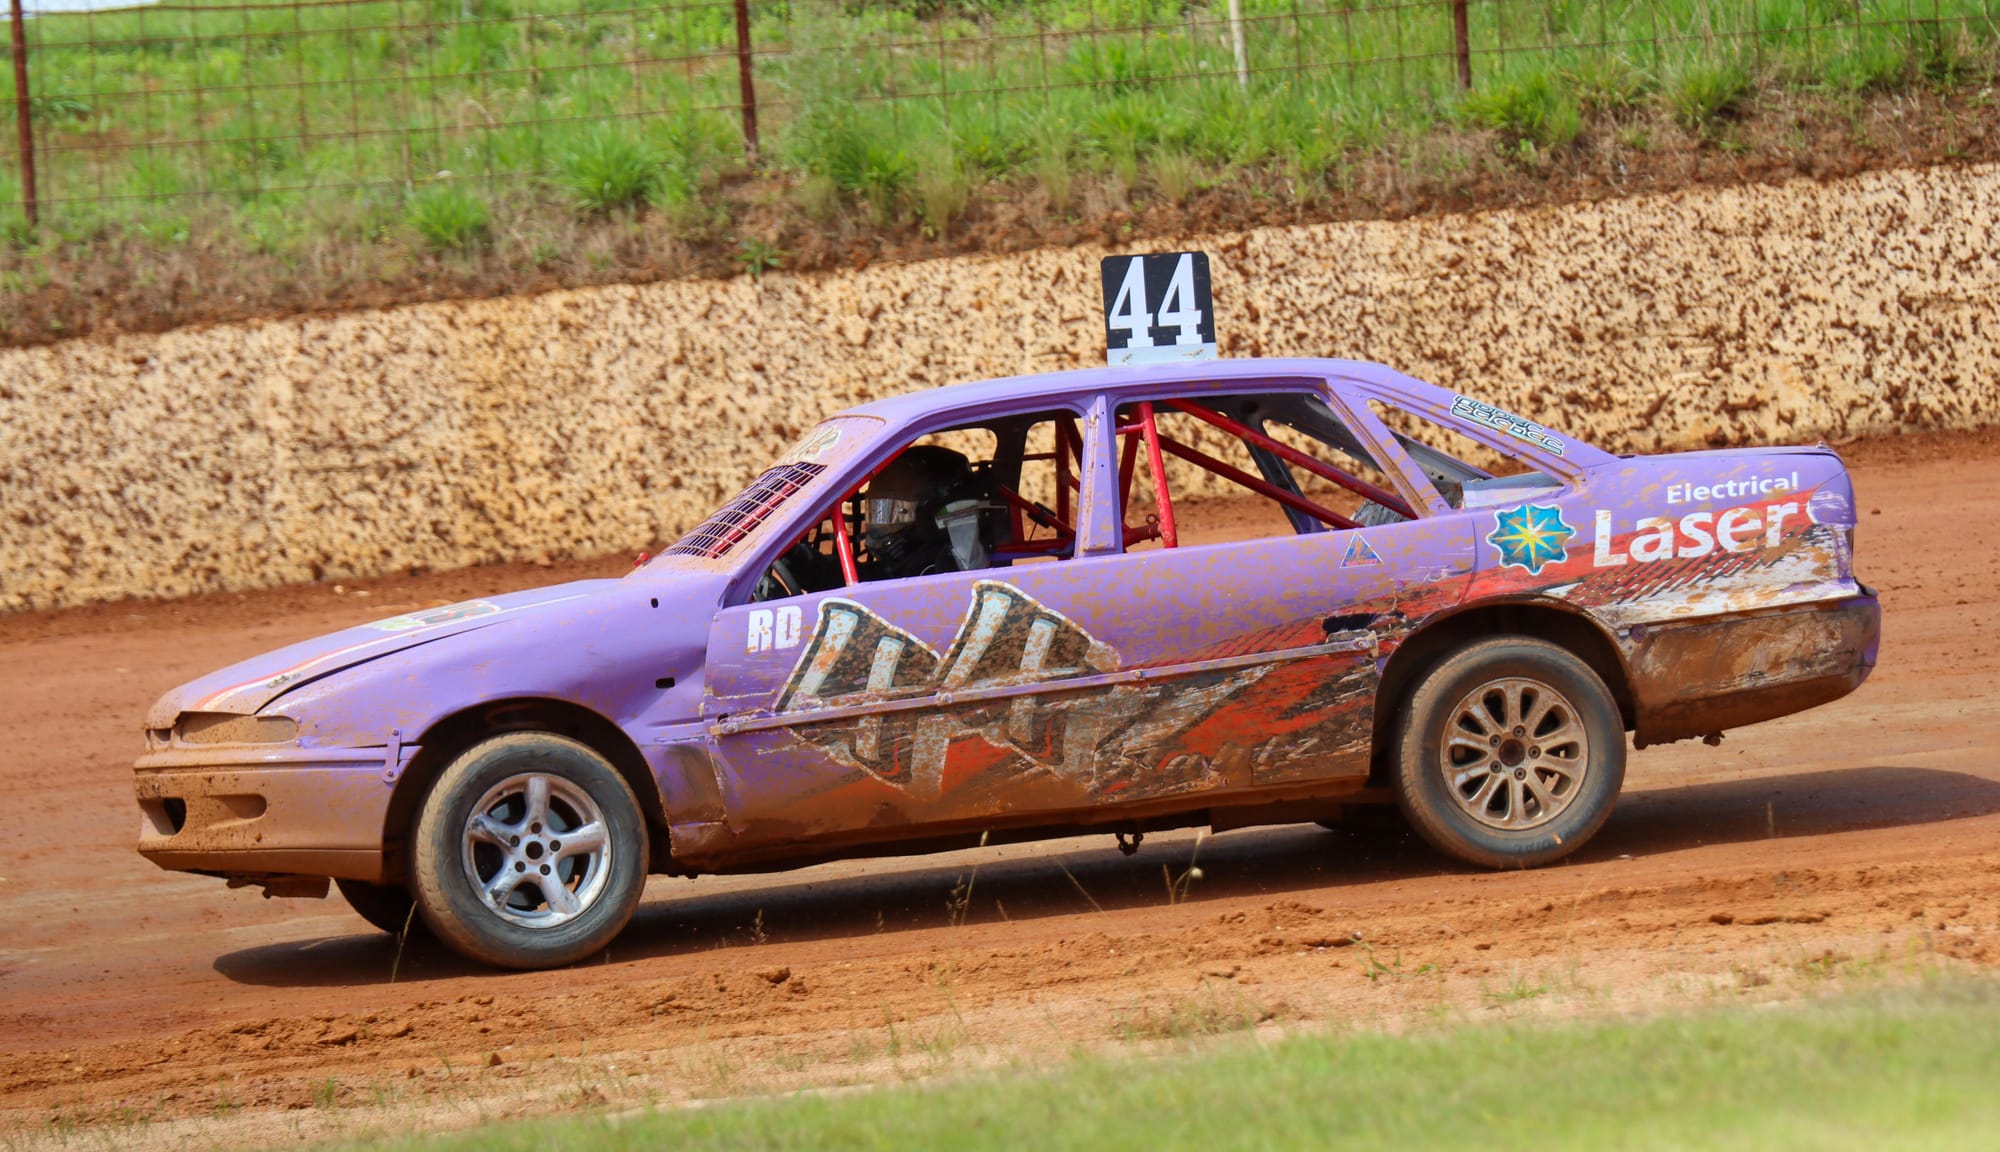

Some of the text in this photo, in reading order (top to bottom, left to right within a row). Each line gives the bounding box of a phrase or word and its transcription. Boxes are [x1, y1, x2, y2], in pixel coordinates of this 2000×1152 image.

[1109, 252, 1203, 349] 44
[1667, 471, 1798, 504] Electrical
[1593, 501, 1798, 568] Laser
[745, 605, 802, 654] RD
